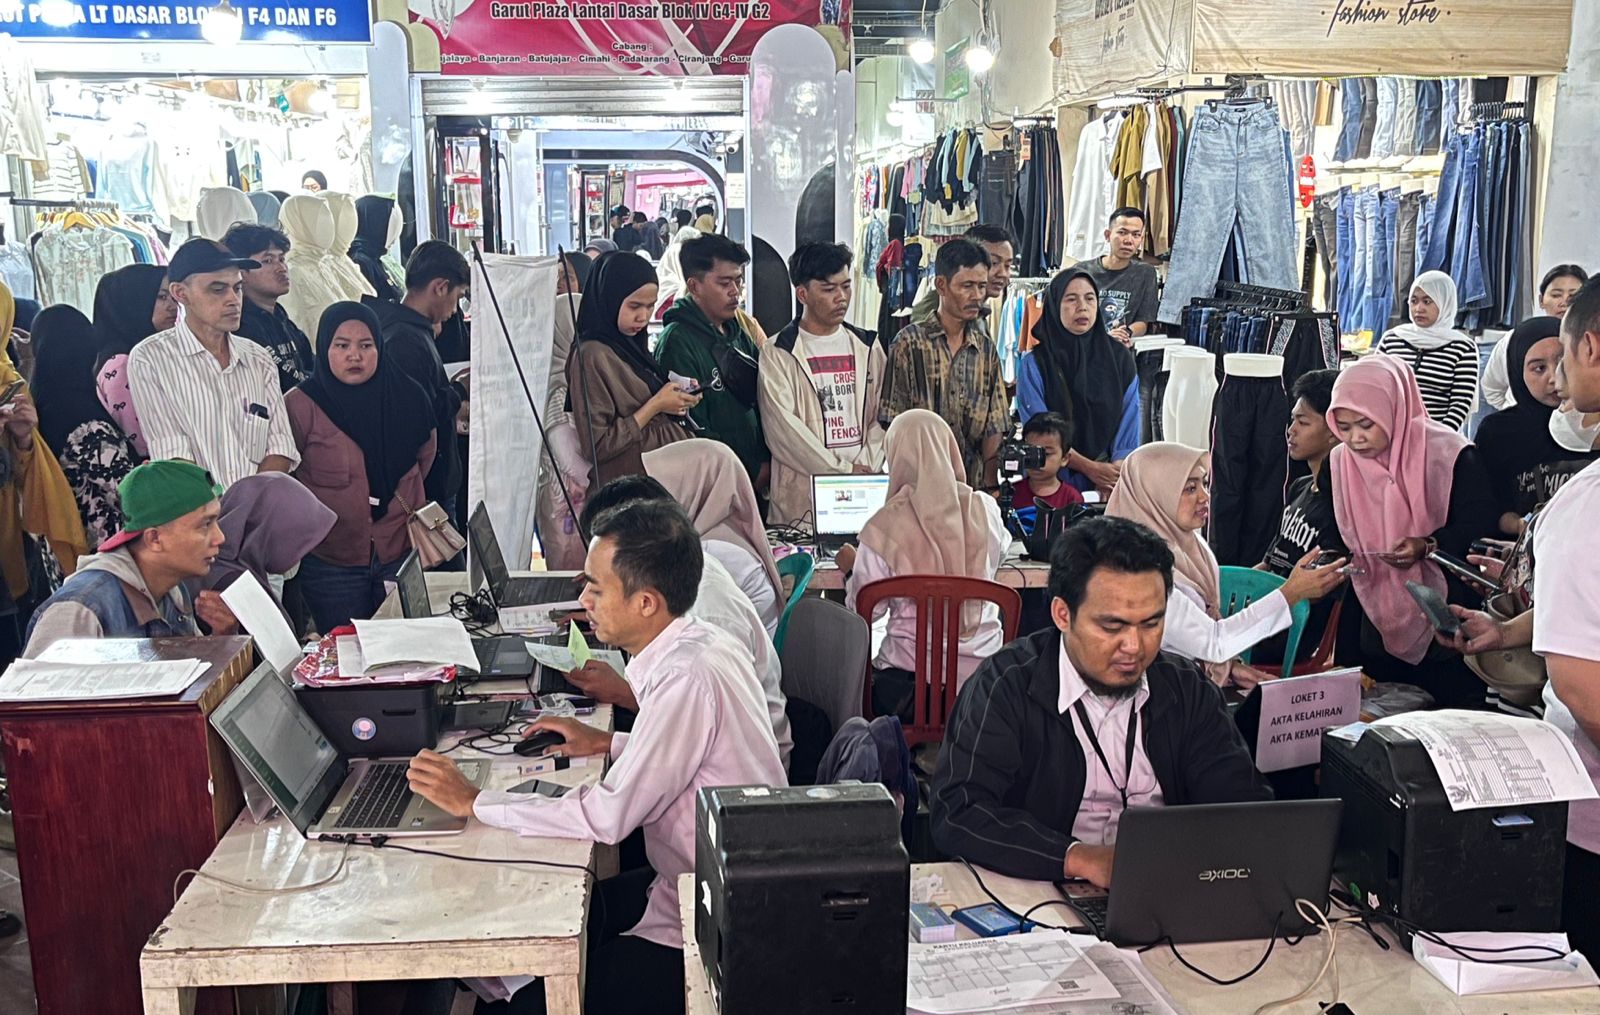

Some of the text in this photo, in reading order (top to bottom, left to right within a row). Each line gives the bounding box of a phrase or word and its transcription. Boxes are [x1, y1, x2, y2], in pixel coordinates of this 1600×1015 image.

[89, 5, 108, 23] LT
[112, 5, 171, 24] DASAR
[248, 8, 270, 25] F4
[274, 8, 310, 26] DAN
[315, 9, 336, 26] F6
[491, 2, 770, 19] Garut Plaza Lantai Dasar Blok IV G4-IV G2
[612, 42, 647, 51] Cabang
[479, 54, 520, 64] Banjaran
[528, 54, 571, 63] Batujajar
[578, 54, 611, 63] Cimahi
[618, 54, 670, 64] Padalarang
[678, 55, 722, 64] Ciranjang
[837, 400, 844, 411] &
[1291, 690, 1325, 704] LOKET 3
[1270, 706, 1343, 726] AKTA KELAHIRAN
[1270, 732, 1293, 744] AKTA
